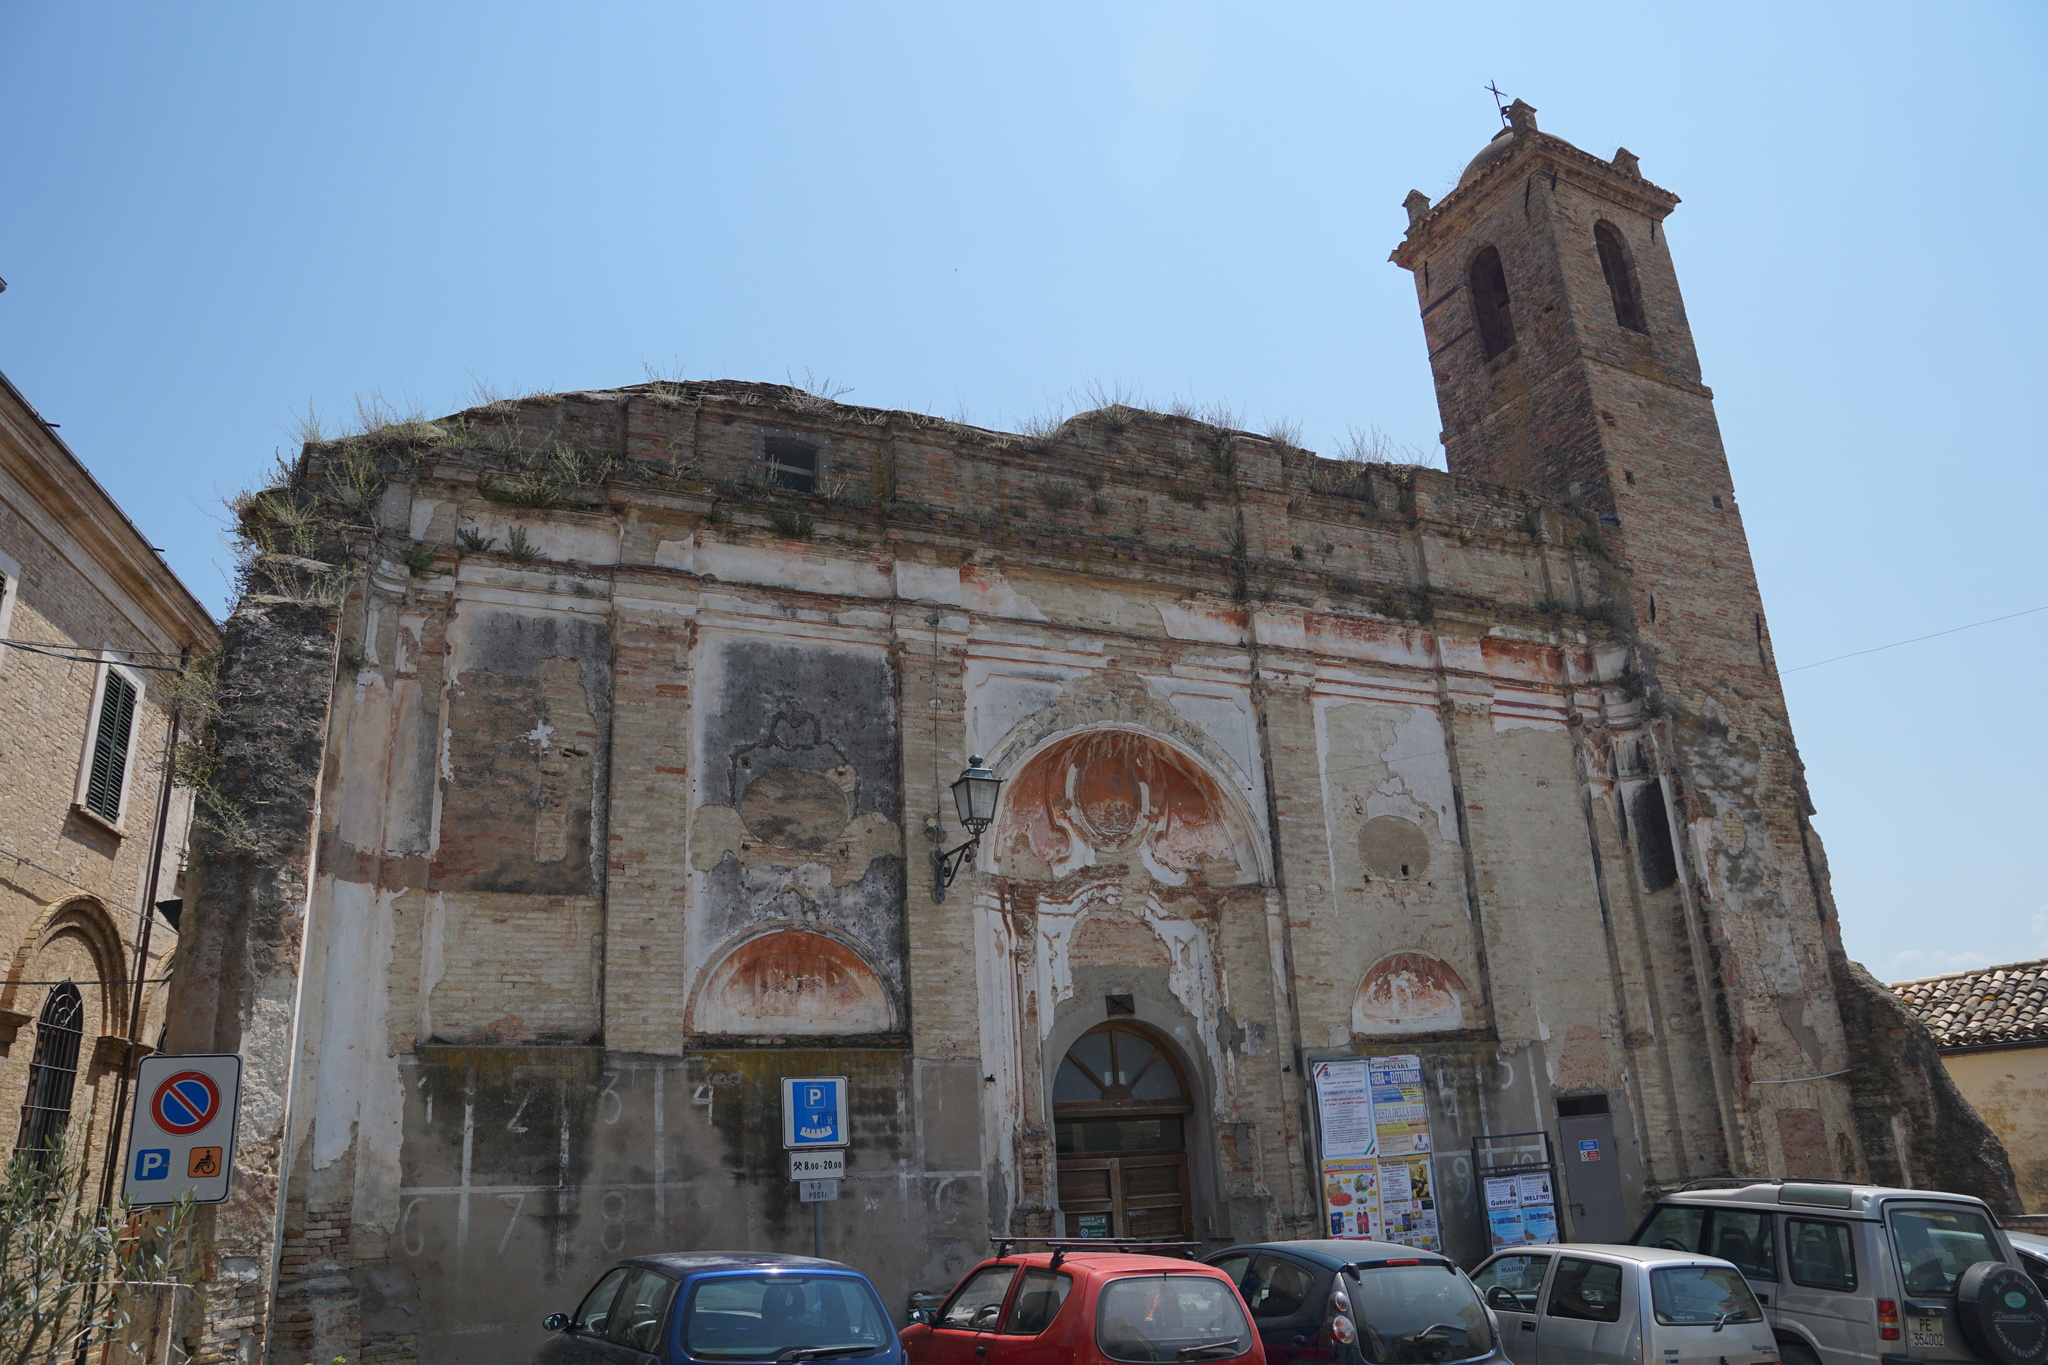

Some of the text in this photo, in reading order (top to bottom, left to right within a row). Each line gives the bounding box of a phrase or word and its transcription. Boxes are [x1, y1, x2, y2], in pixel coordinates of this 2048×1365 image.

[1371, 1072, 1385, 1085] FIERA
[1390, 1070, 1421, 1084] ELETTRONICA
[810, 1089, 822, 1106] P
[692, 1082, 713, 1127] 4
[1392, 1107, 1409, 1118] DELLA
[142, 1153, 162, 1177] P
[824, 1160, 842, 1170] 20.00
[1490, 1198, 1518, 1207] Gabriele
[1523, 1193, 1550, 1202] MELFINO
[1501, 1265, 1523, 1274] MARIO
[1919, 1318, 1932, 1331] PE
[1913, 1332, 1945, 1346] 354002
